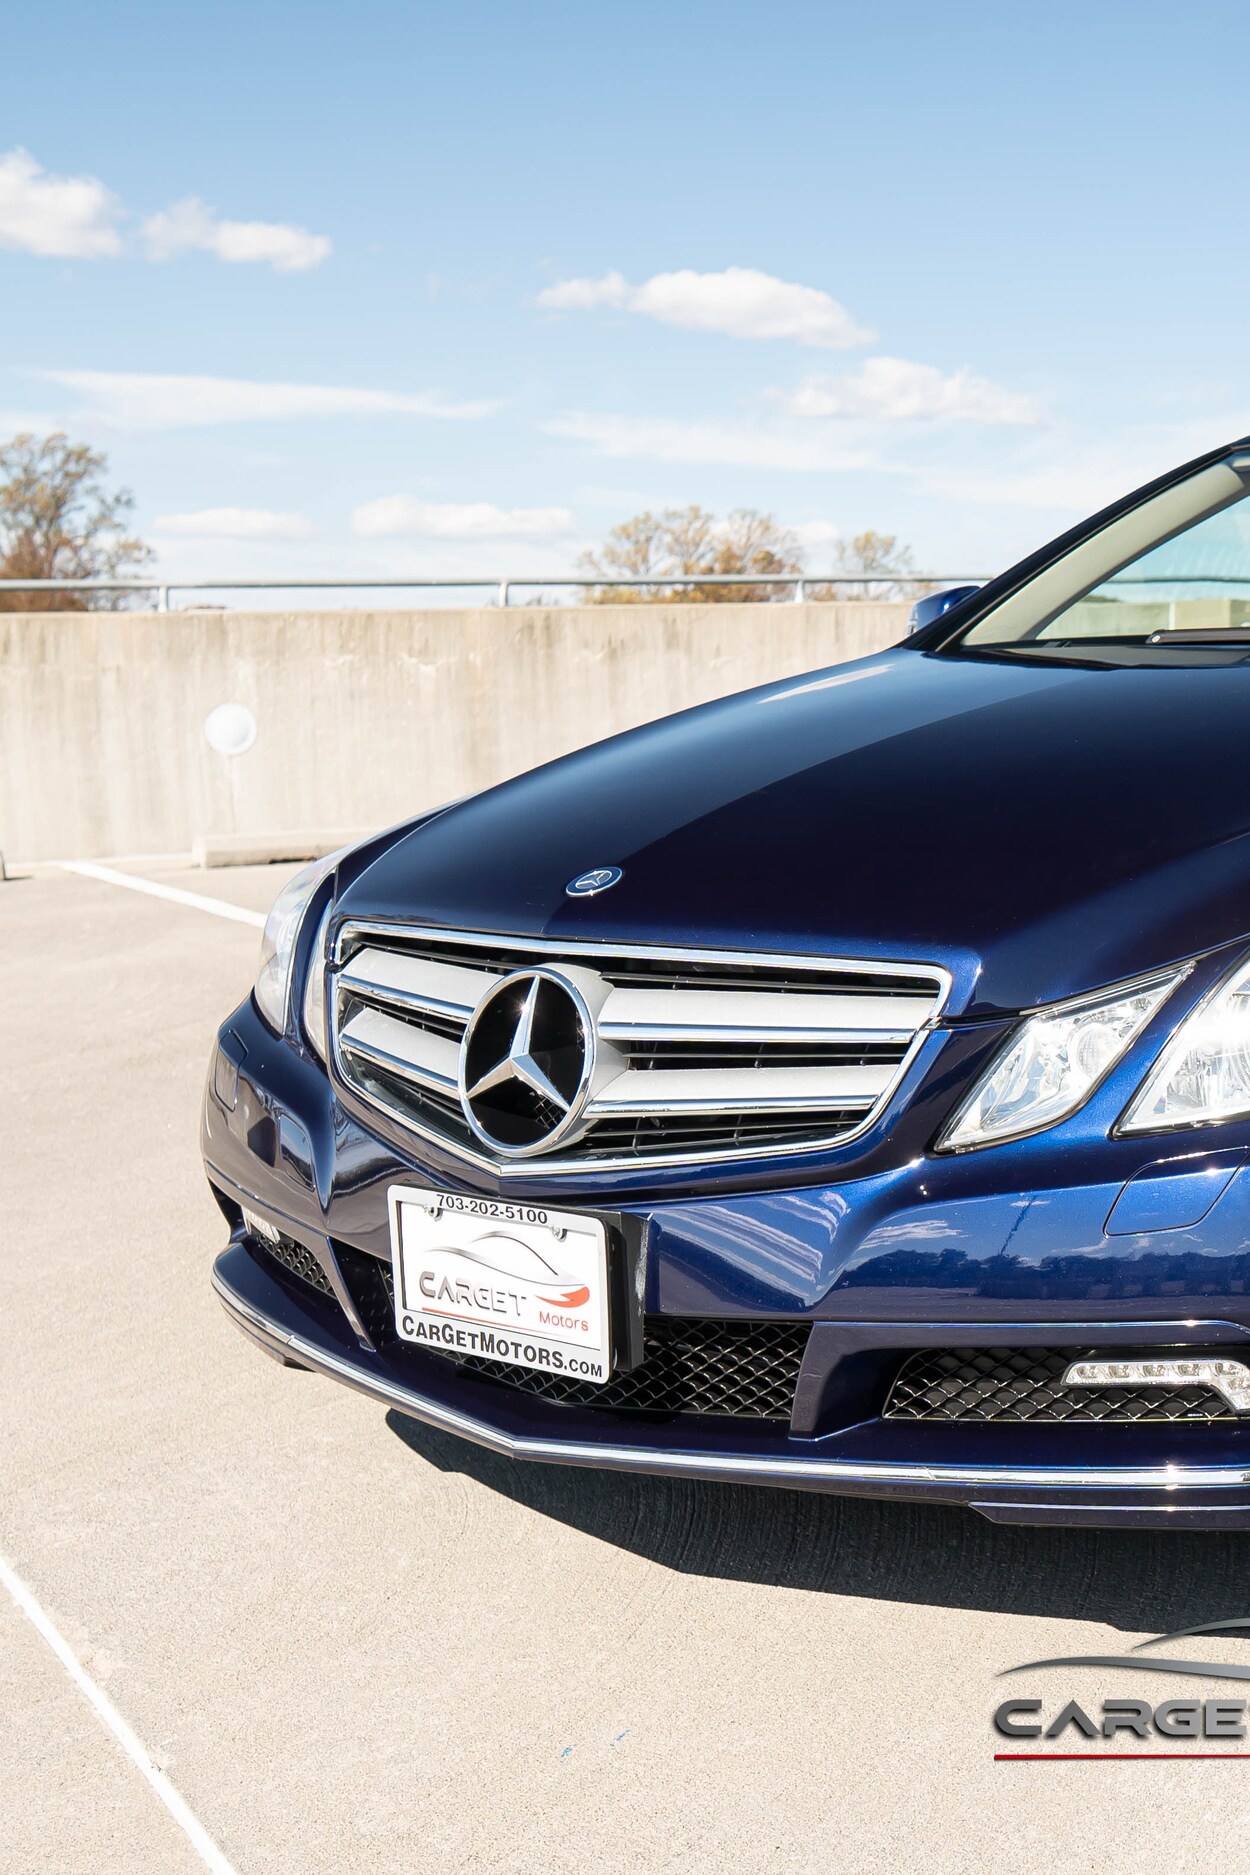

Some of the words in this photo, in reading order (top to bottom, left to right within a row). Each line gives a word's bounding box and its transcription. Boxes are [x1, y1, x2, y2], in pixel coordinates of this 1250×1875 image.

[436, 1193, 548, 1225] 703-202-5100
[419, 1270, 527, 1317] CARGET
[539, 1310, 589, 1332] Motors
